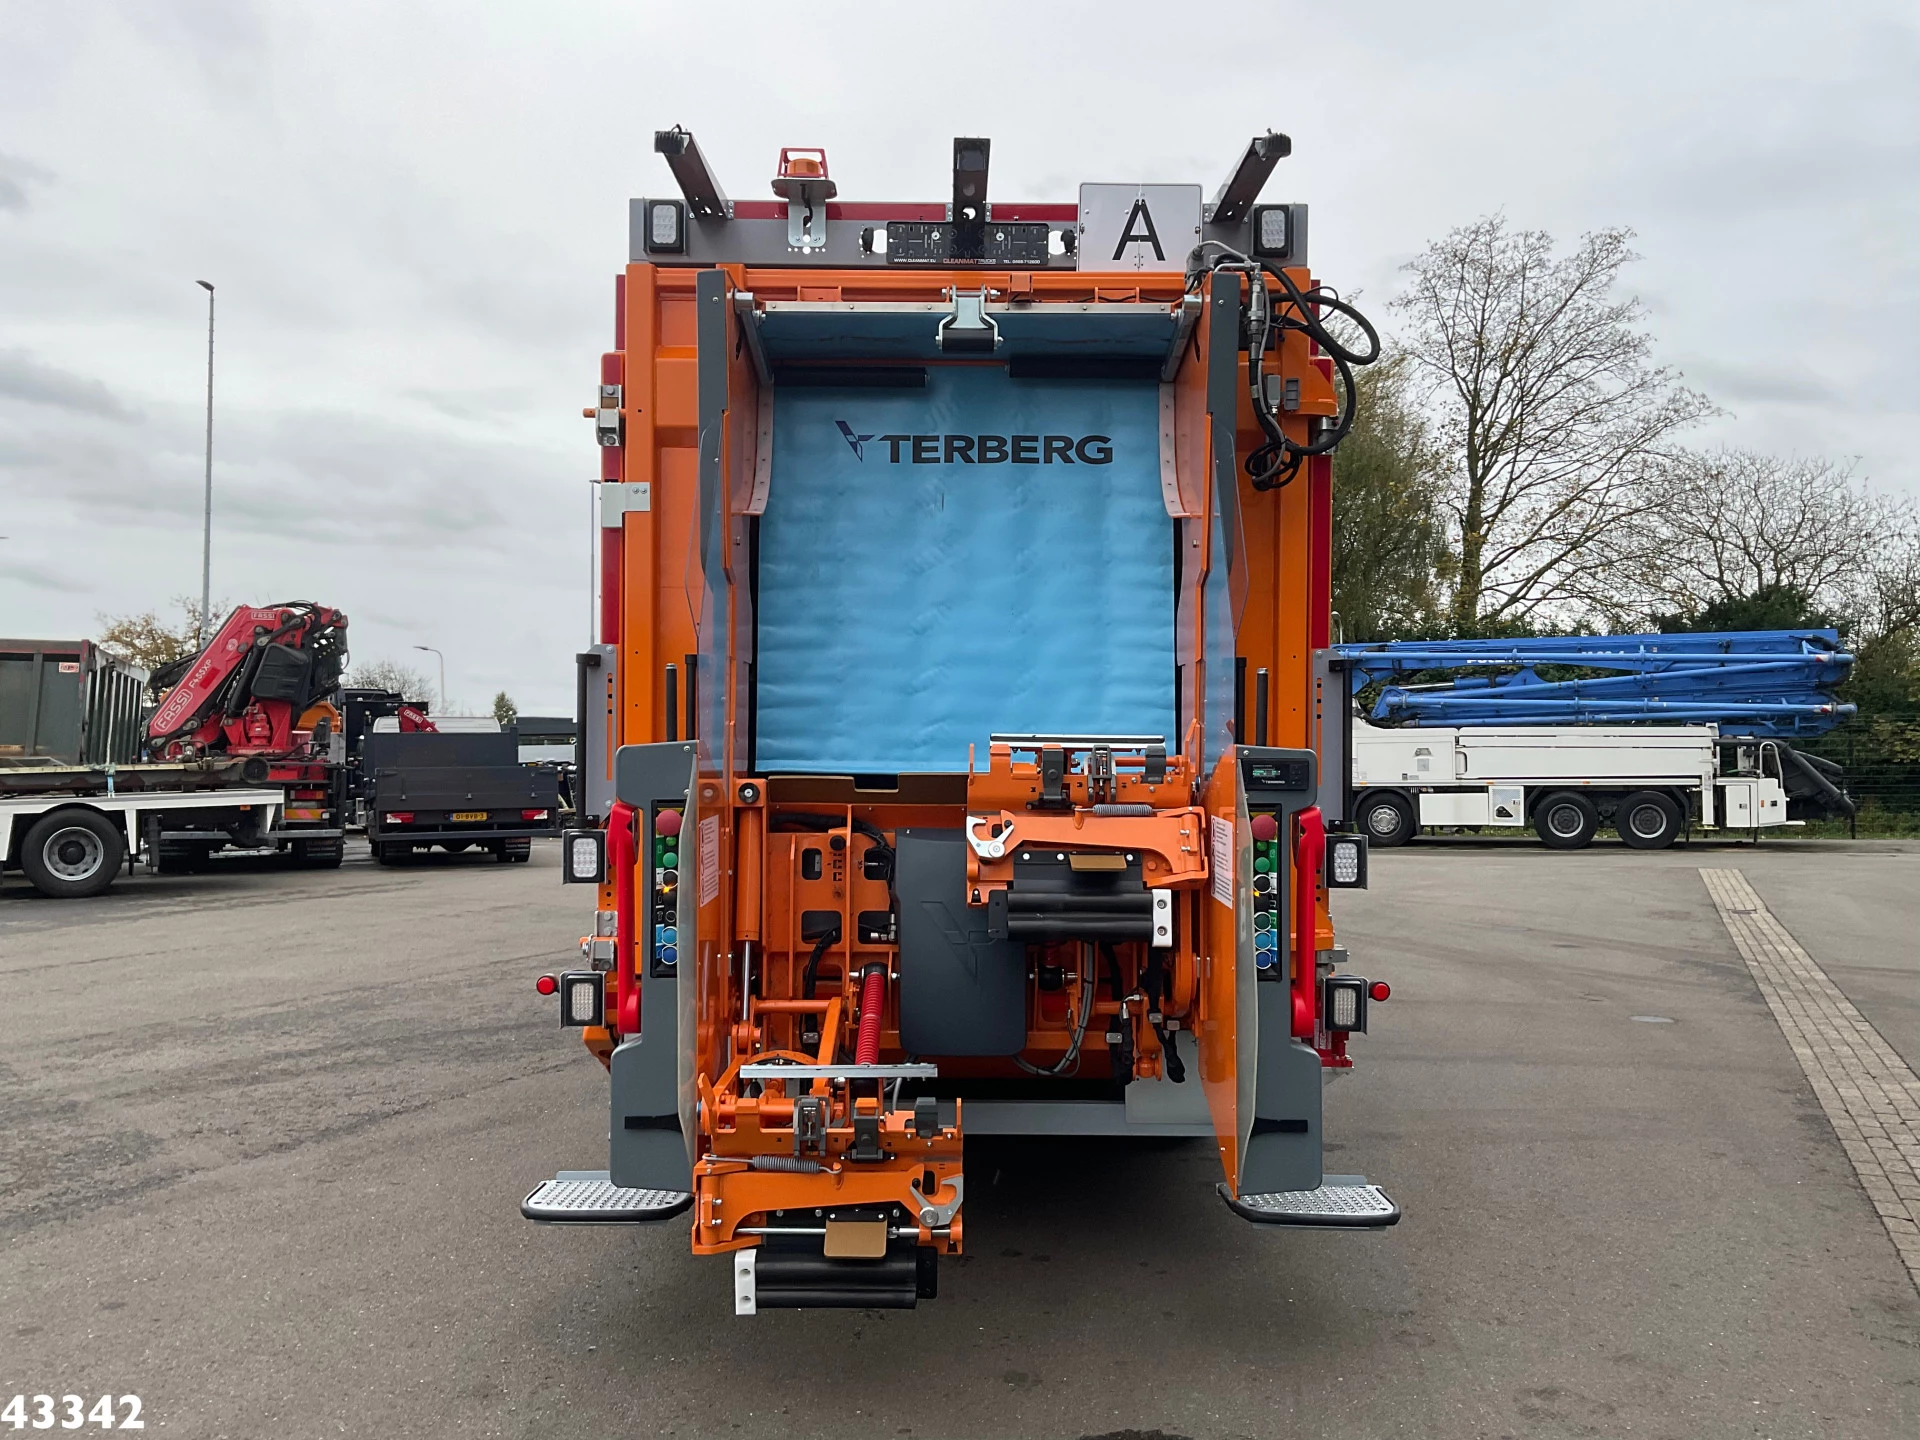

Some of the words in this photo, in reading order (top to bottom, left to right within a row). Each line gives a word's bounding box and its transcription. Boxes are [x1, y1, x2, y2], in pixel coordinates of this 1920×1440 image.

[1112, 199, 1166, 261] A
[878, 435, 1113, 464] TERBERG
[188, 659, 212, 688] F455XP
[157, 692, 190, 728] FASSI
